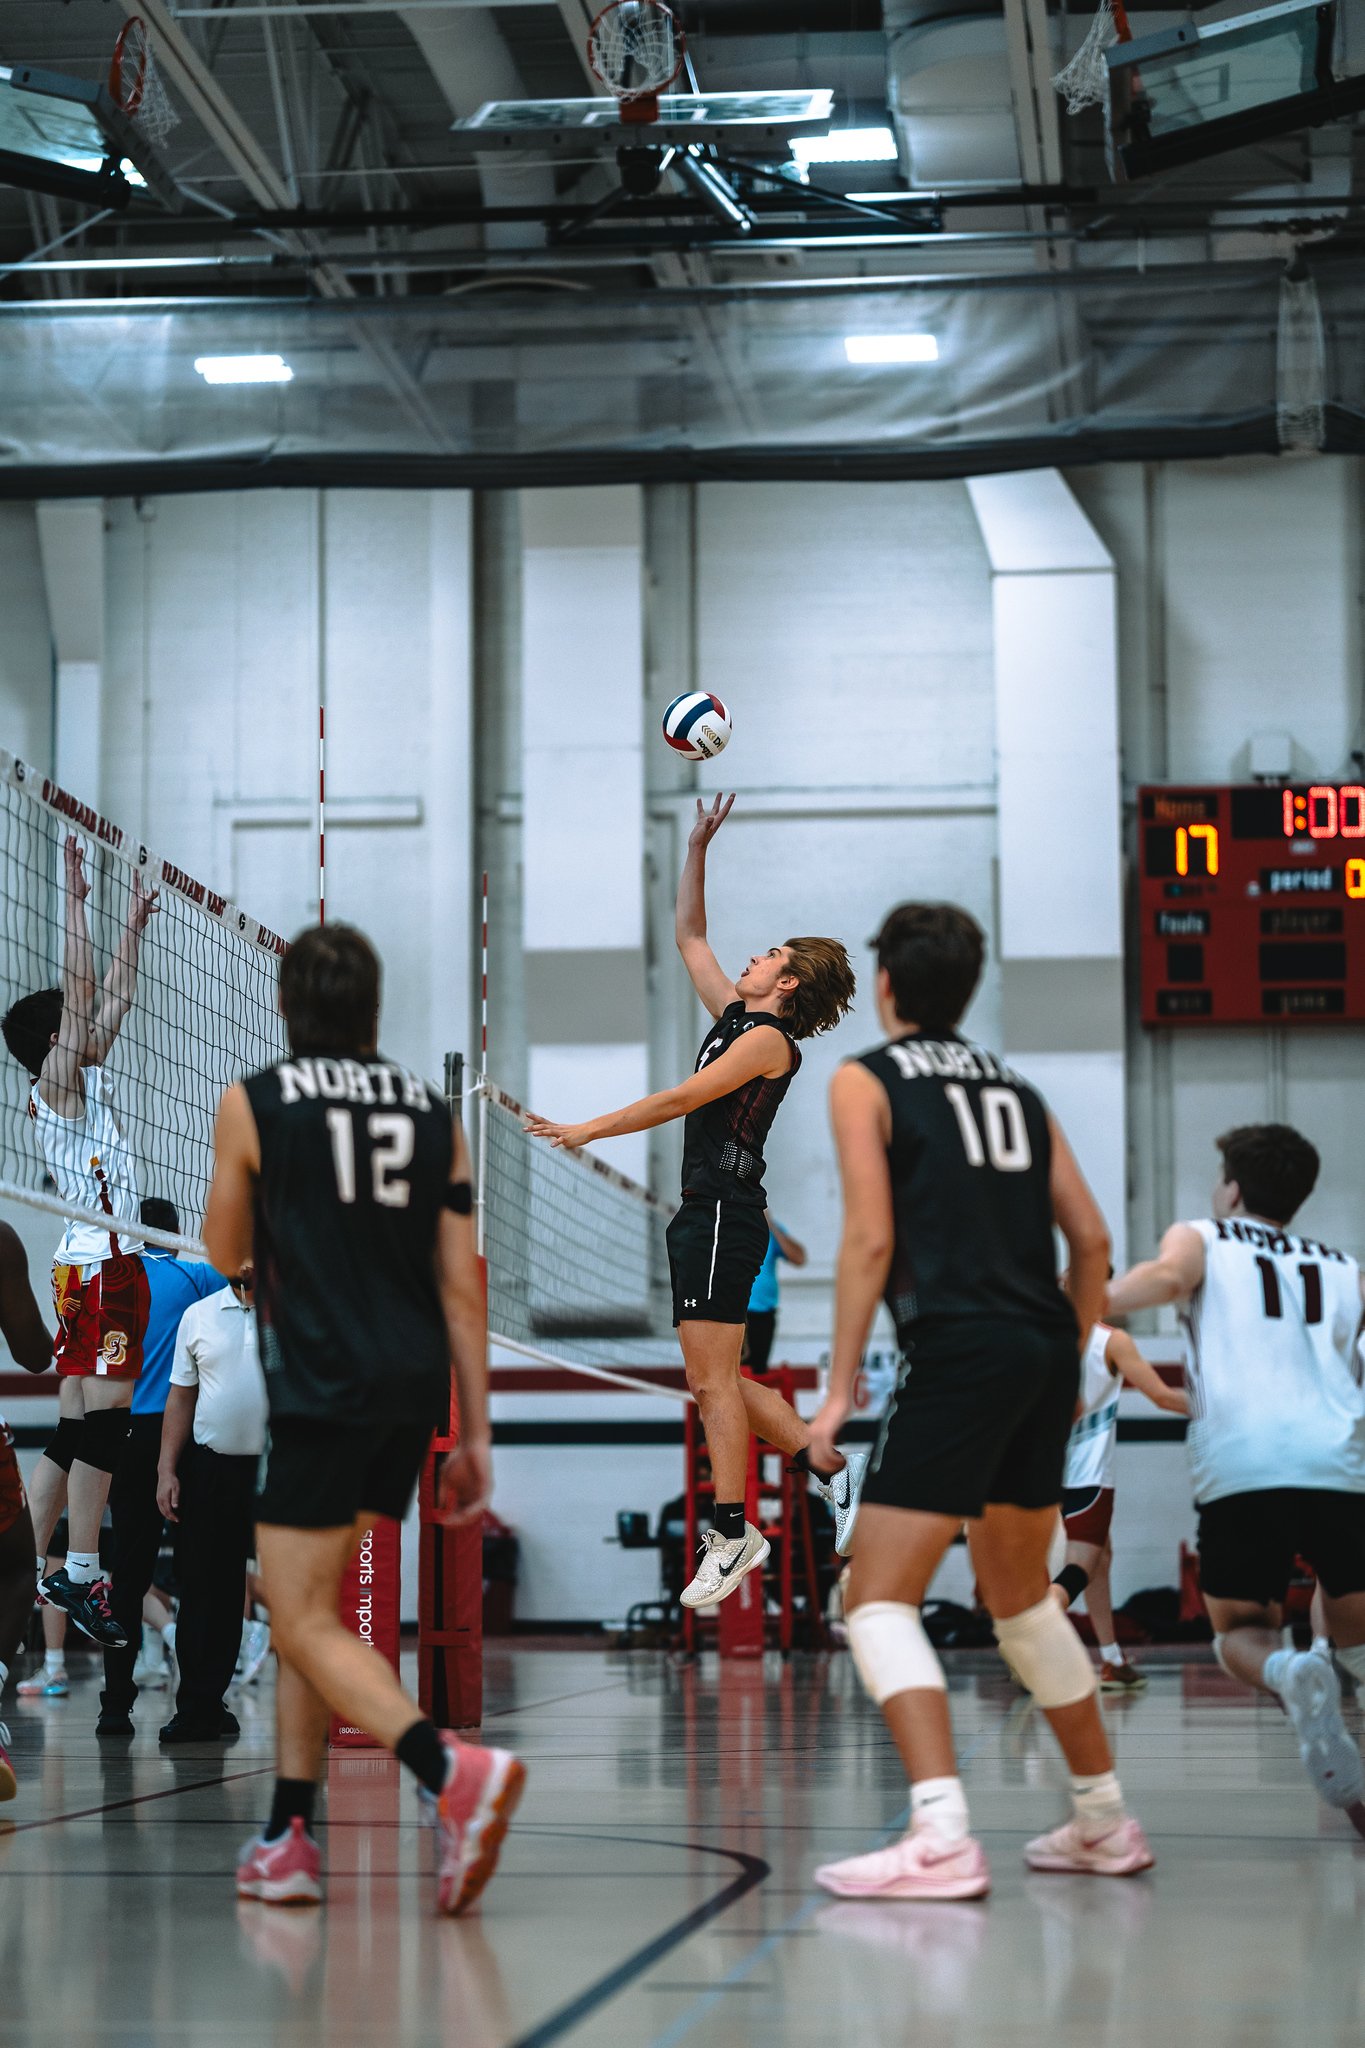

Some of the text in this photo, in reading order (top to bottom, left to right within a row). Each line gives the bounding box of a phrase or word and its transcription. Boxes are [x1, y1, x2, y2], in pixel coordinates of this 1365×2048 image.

[1282, 786, 1365, 838] 1:00
[1175, 824, 1218, 876] 17
[1270, 866, 1333, 894] period
[277, 1056, 432, 1113] NORTH
[944, 1083, 1032, 1172] 10
[325, 1107, 415, 1208] 12
[1212, 1218, 1347, 1264] NORTH
[1255, 1256, 1323, 1323] 11
[355, 1529, 375, 1648] sports import
